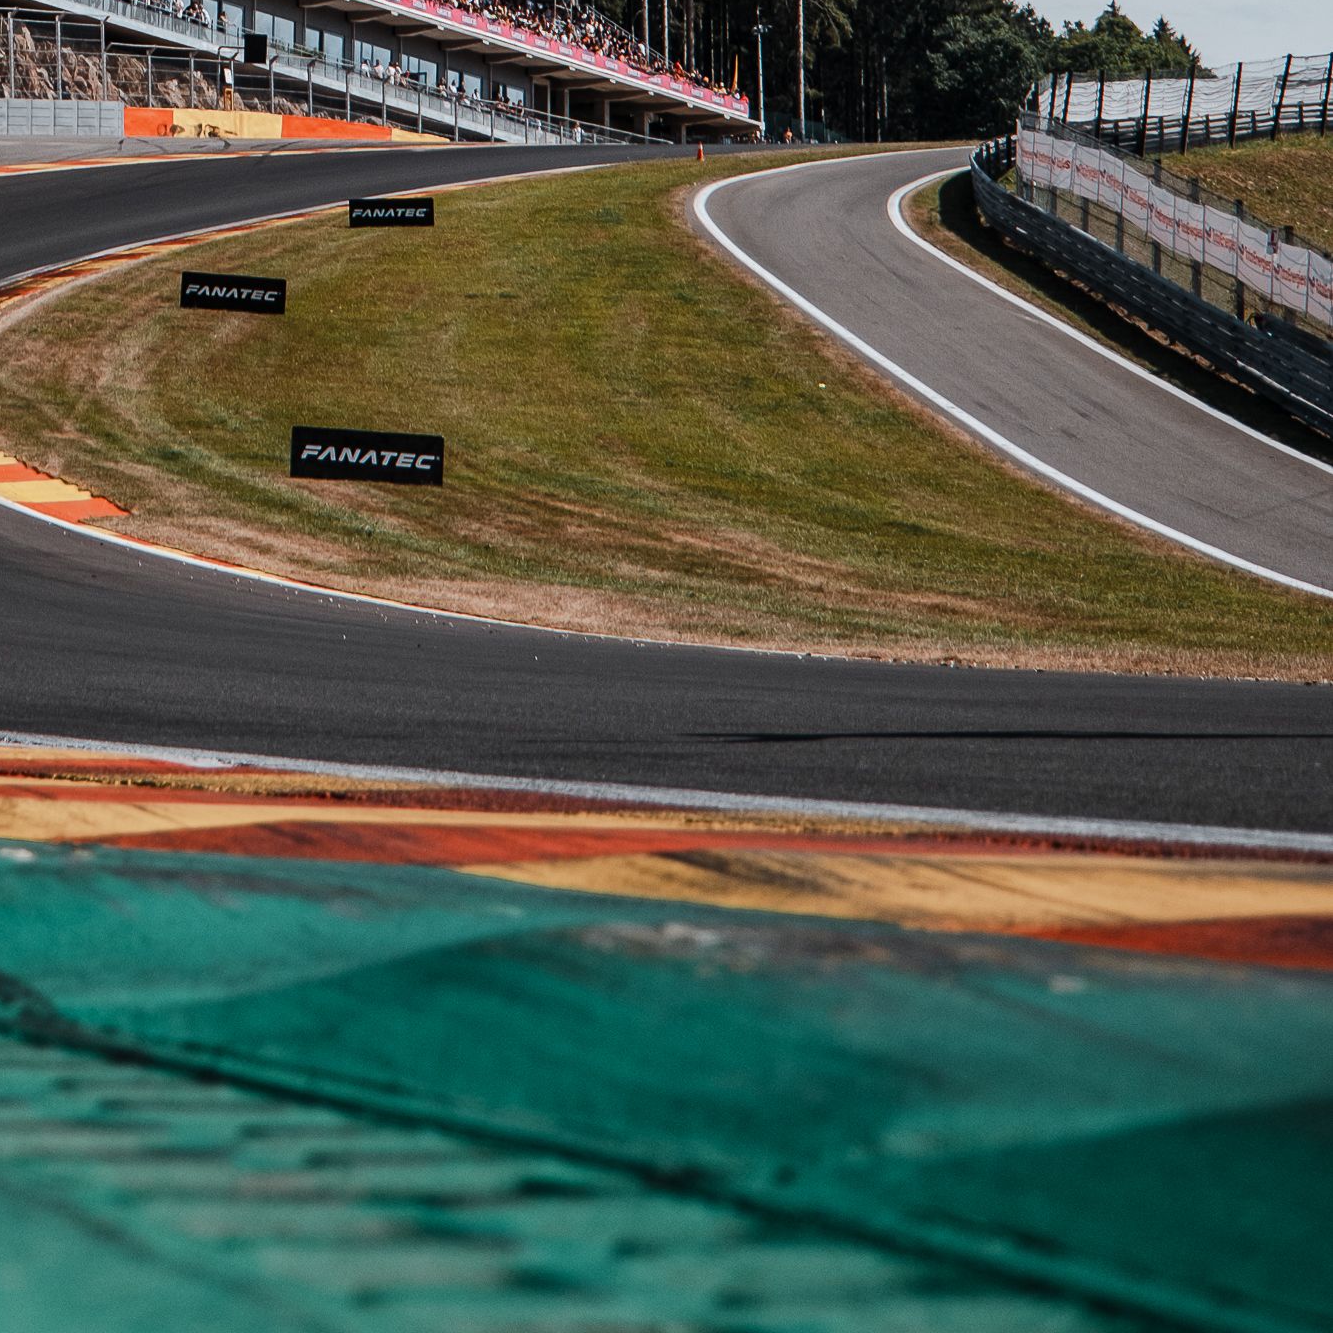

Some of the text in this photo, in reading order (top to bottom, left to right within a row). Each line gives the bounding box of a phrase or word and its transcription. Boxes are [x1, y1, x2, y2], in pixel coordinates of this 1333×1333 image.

[352, 208, 427, 218] FANATEC
[186, 284, 279, 301] FANATEC
[301, 444, 435, 470] FANATEC
